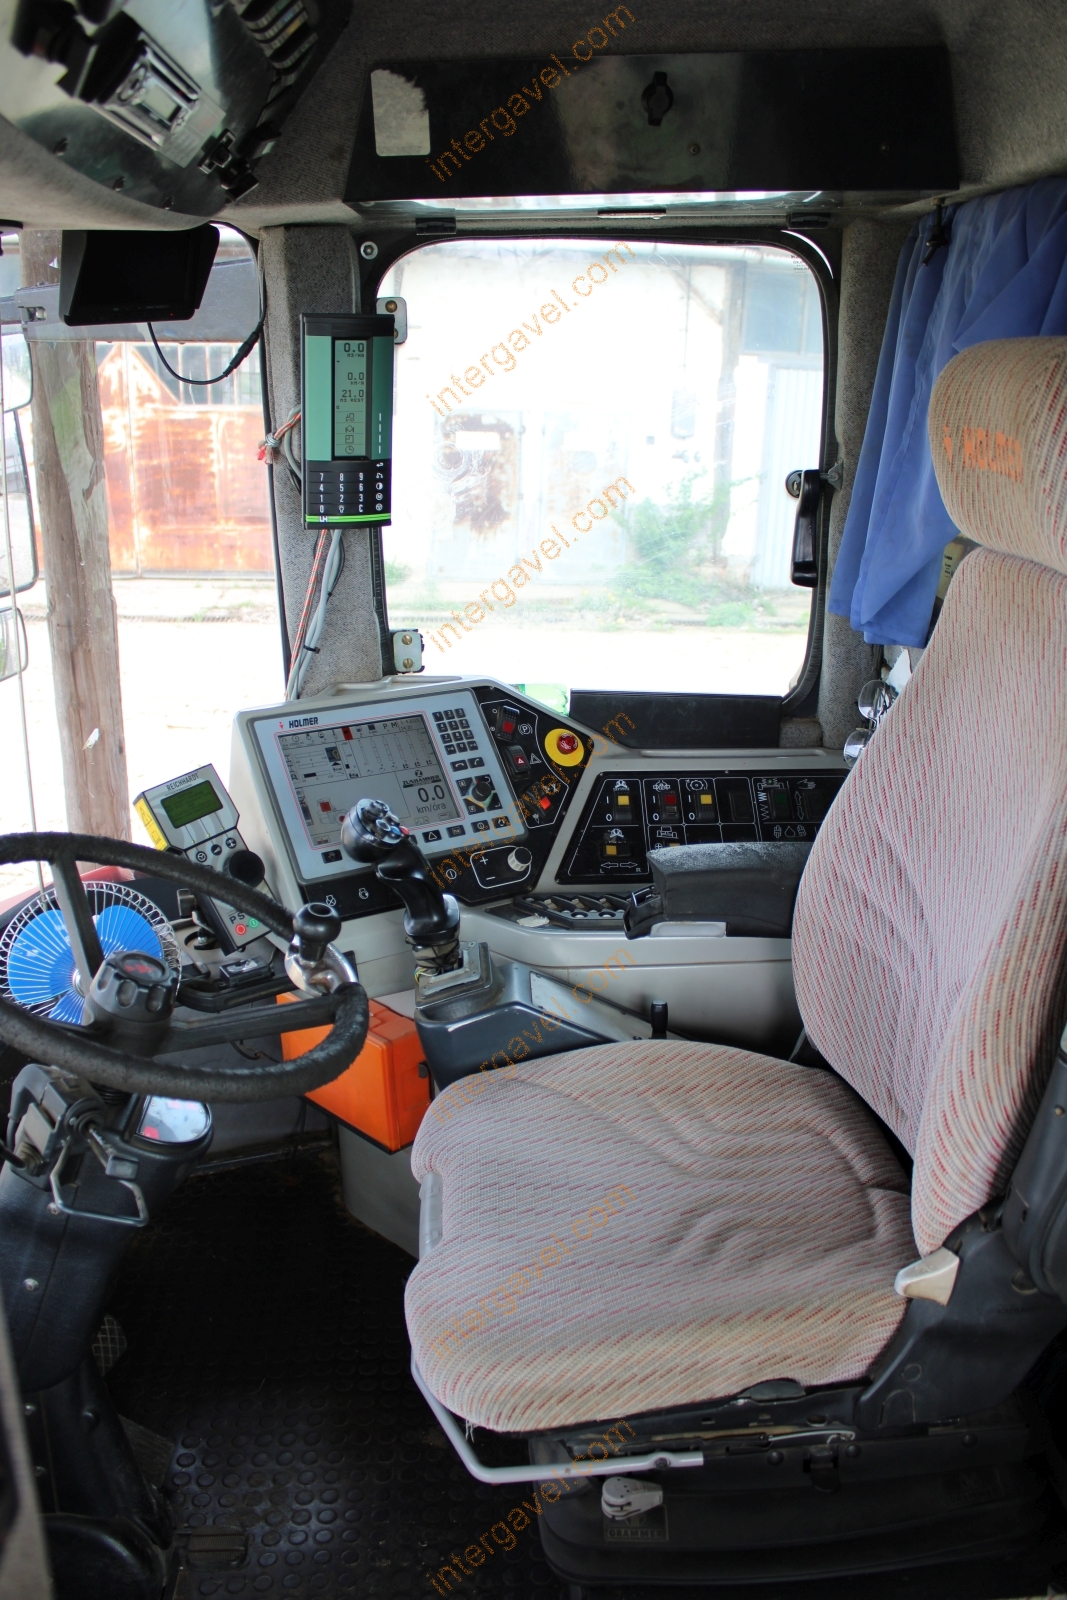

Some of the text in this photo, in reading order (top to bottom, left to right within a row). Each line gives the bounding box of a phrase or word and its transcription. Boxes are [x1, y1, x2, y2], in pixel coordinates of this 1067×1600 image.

[344, 342, 365, 353] 0.0
[347, 371, 365, 381] 0.0
[341, 389, 365, 398] 21.0
[288, 716, 319, 728] HOLMER
[166, 772, 200, 791] REICHHARDT
[417, 784, 445, 803] 0.0
[416, 802, 447, 814] km/óra
[608, 1528, 662, 1538] GRAMMER
